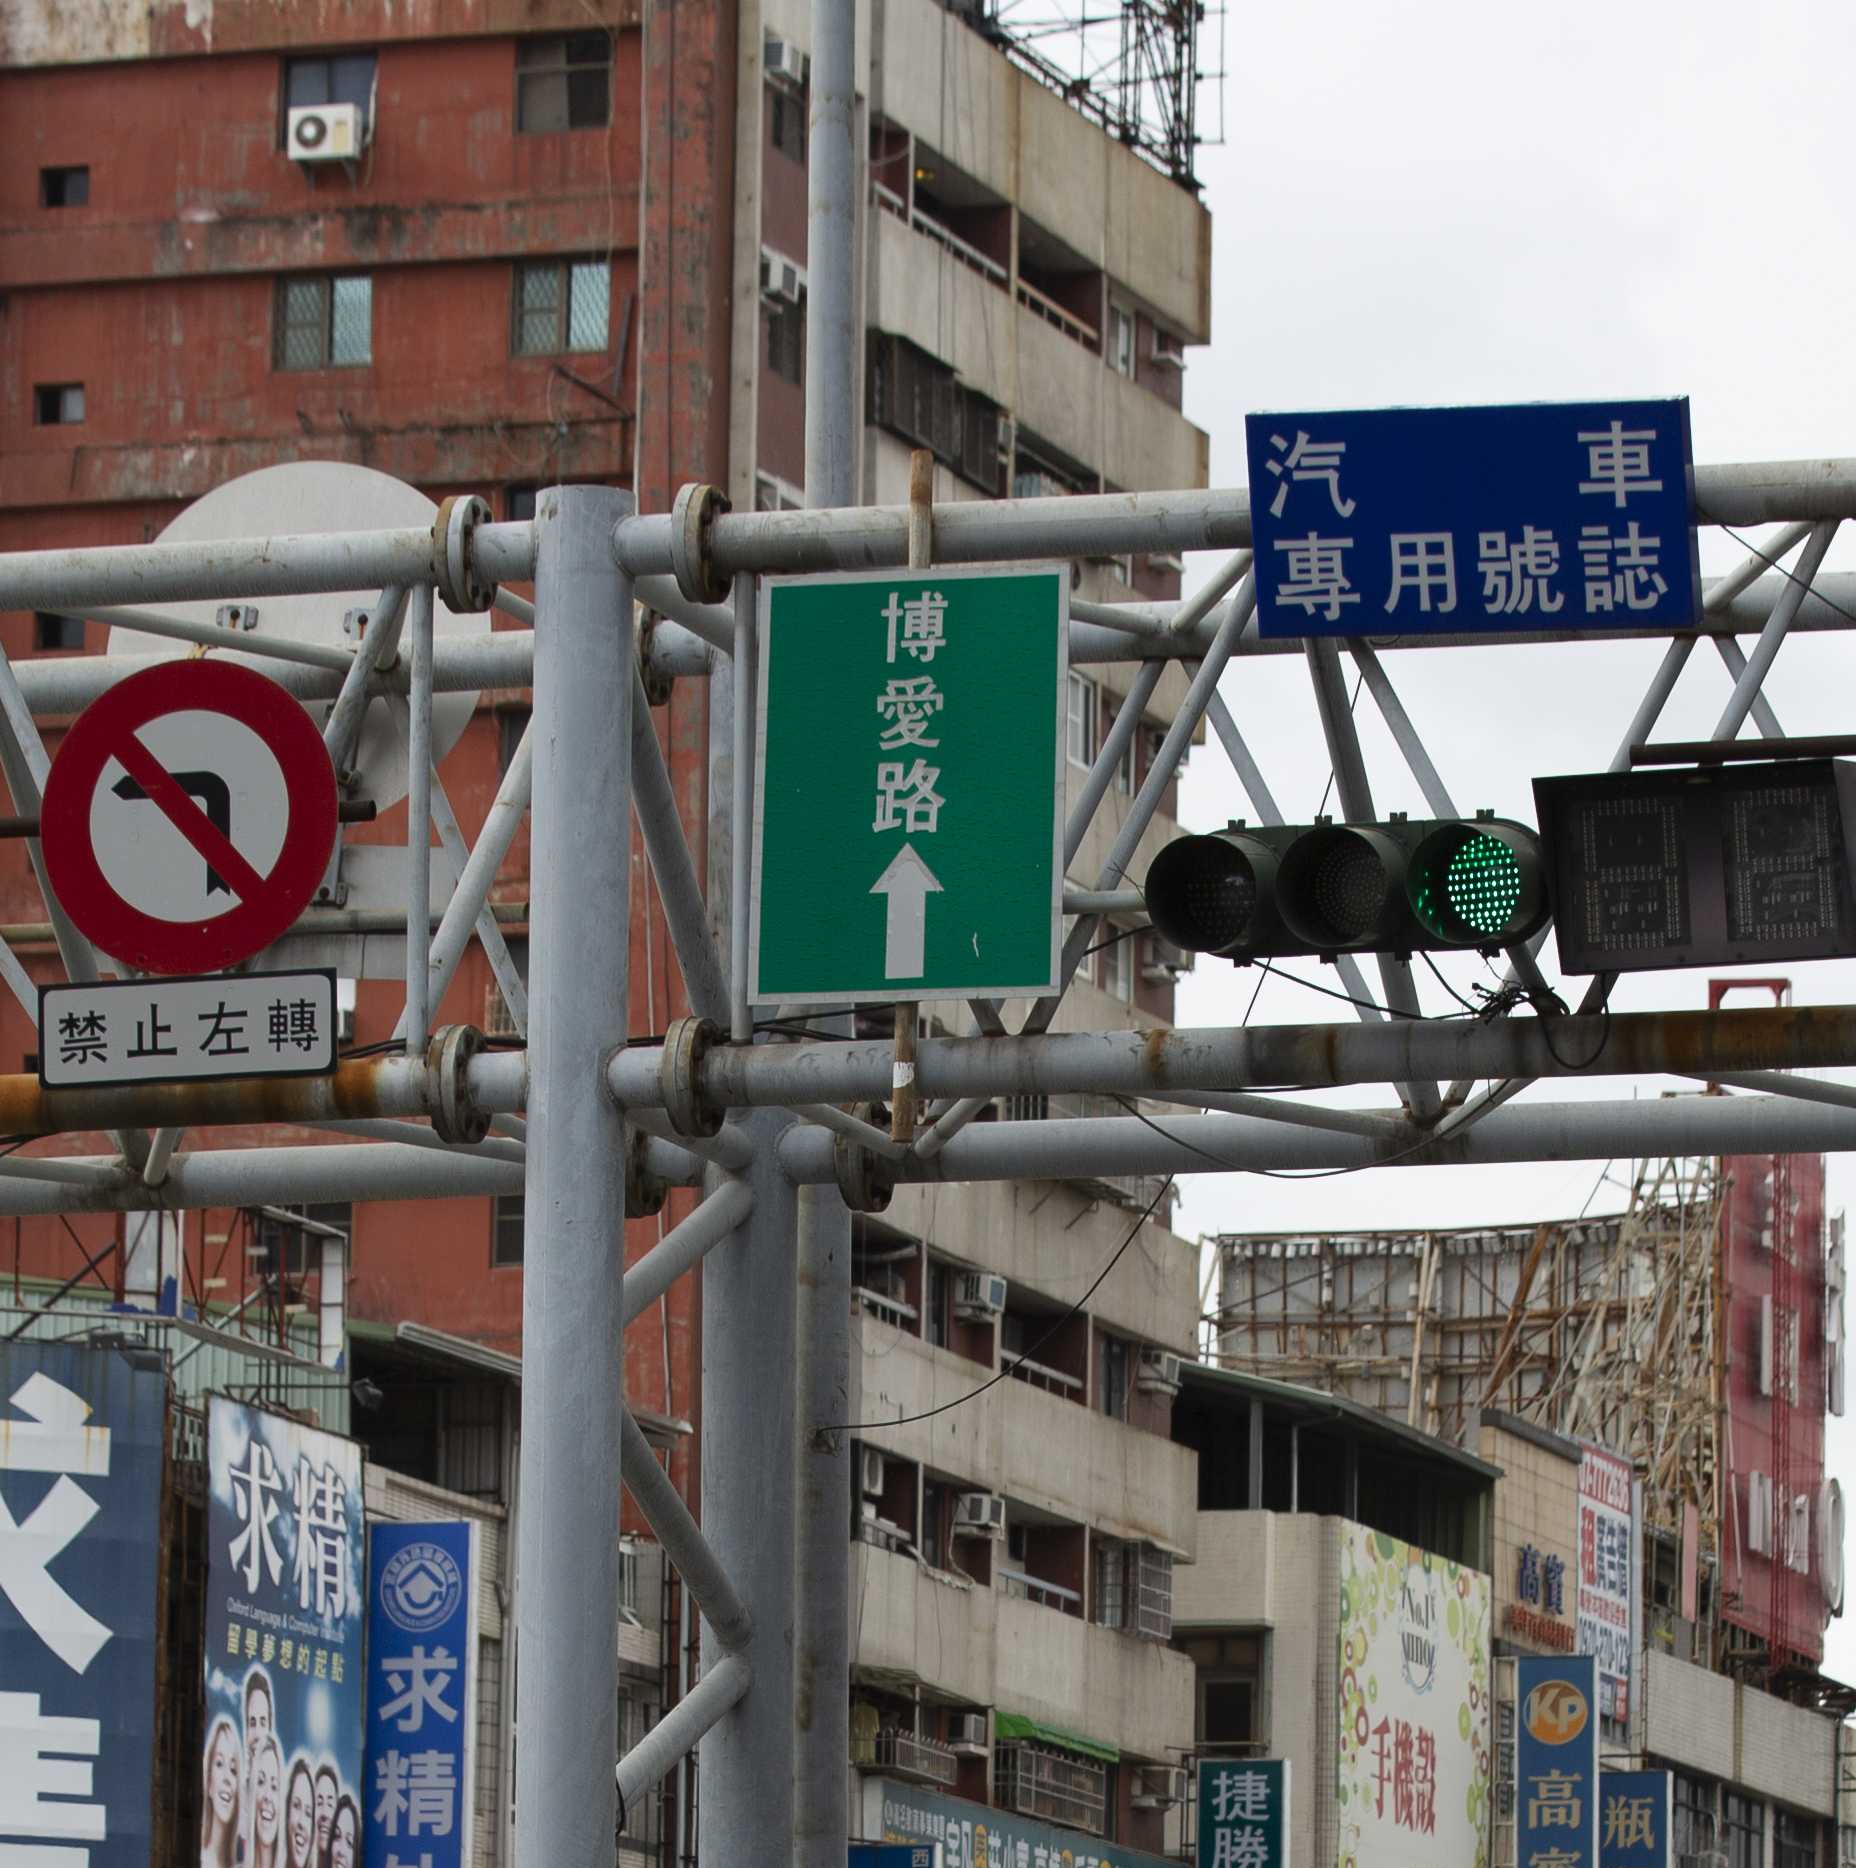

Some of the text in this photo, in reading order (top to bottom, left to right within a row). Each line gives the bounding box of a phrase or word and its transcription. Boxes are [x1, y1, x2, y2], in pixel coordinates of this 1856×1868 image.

[1265, 420, 1663, 521] 汽車
[1274, 521, 1667, 622] 專用號誌
[870, 590, 949, 834] 博愛路
[58, 998, 320, 1066] 禁止左轉
[229, 1440, 348, 1620] 求精
[1371, 1715, 1437, 1836] 手機殼
